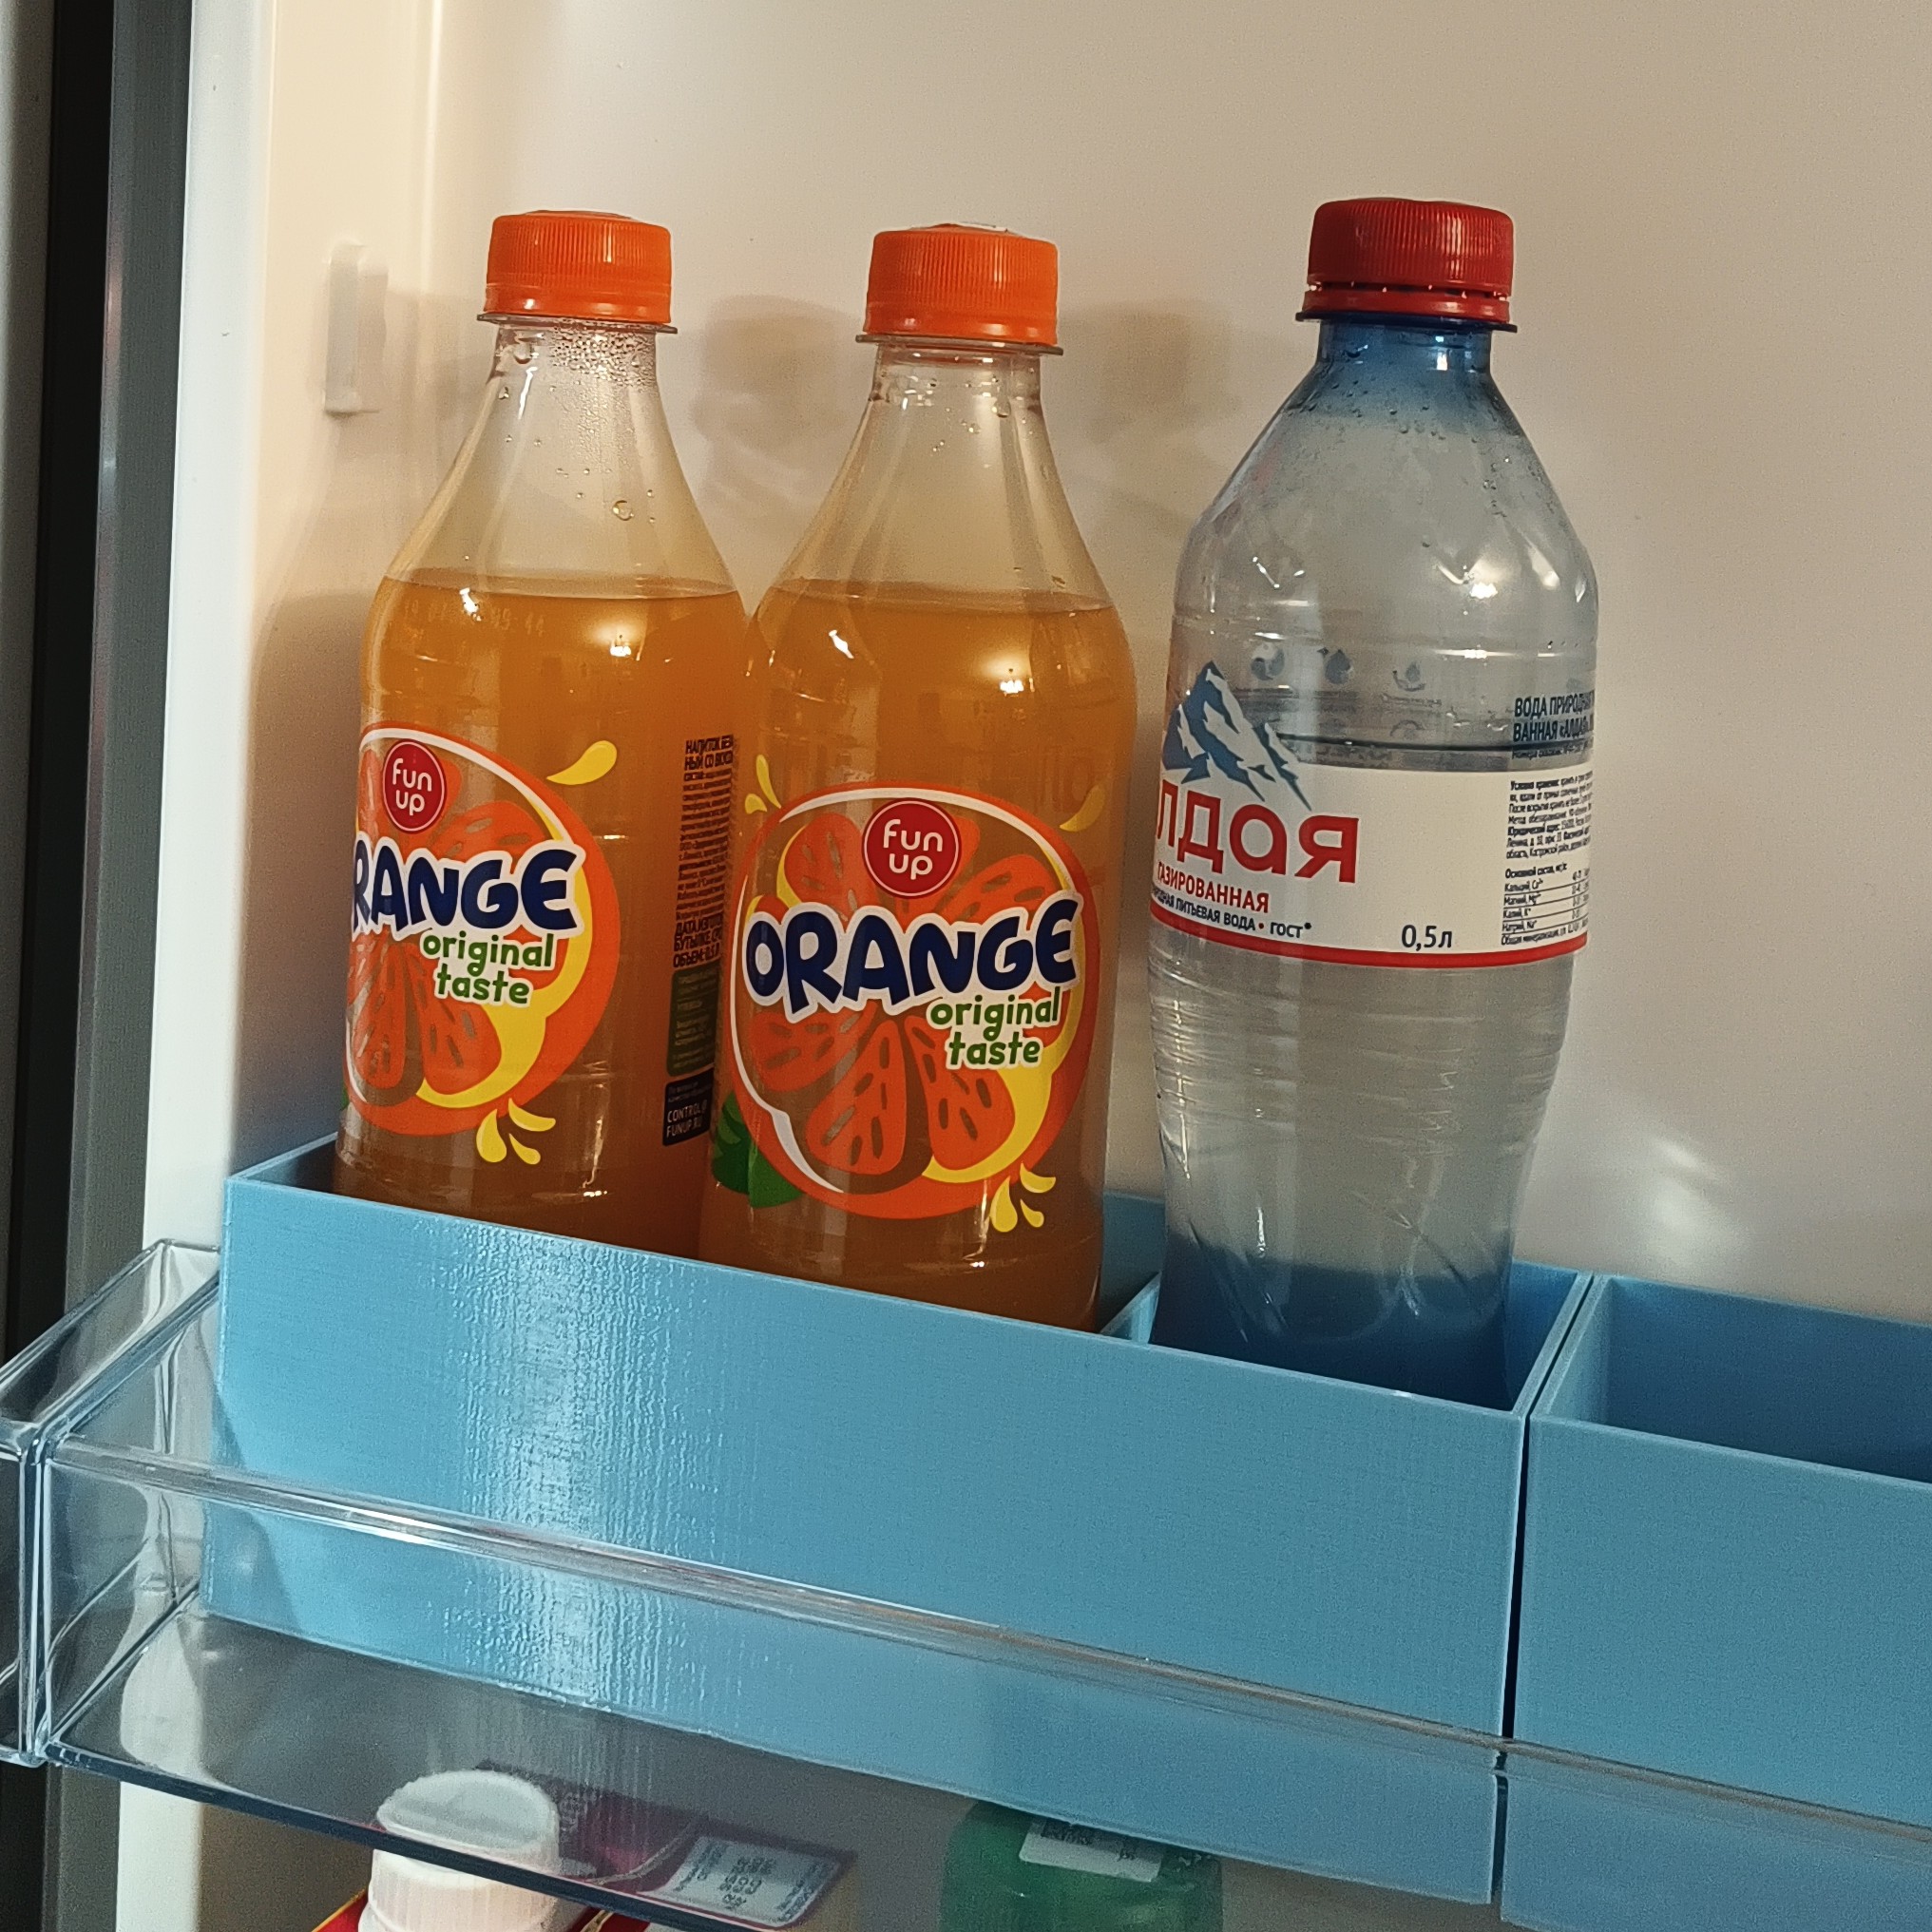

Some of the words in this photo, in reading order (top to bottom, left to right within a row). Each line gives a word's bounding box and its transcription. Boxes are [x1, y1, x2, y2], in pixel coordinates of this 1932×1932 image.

[1514, 696, 1547, 719] ВОДА
[1513, 720, 1559, 742] ВАННАЯ
[392, 757, 432, 792] fun
[395, 790, 426, 815] up
[883, 818, 943, 851] fun
[889, 853, 933, 880] up
[353, 838, 578, 933] RANGE
[1157, 861, 1270, 913] ГАЗИРОВАННАЯ
[1176, 897, 1221, 924] ПИТЬЕВАЯ
[1223, 911, 1256, 931] ВОДА
[423, 929, 555, 978] original
[1401, 924, 1453, 951] 0,5л
[746, 898, 1080, 1015] ORANGE
[436, 962, 530, 1004] taste
[929, 986, 1061, 1043] original
[948, 1031, 1042, 1066] taste
